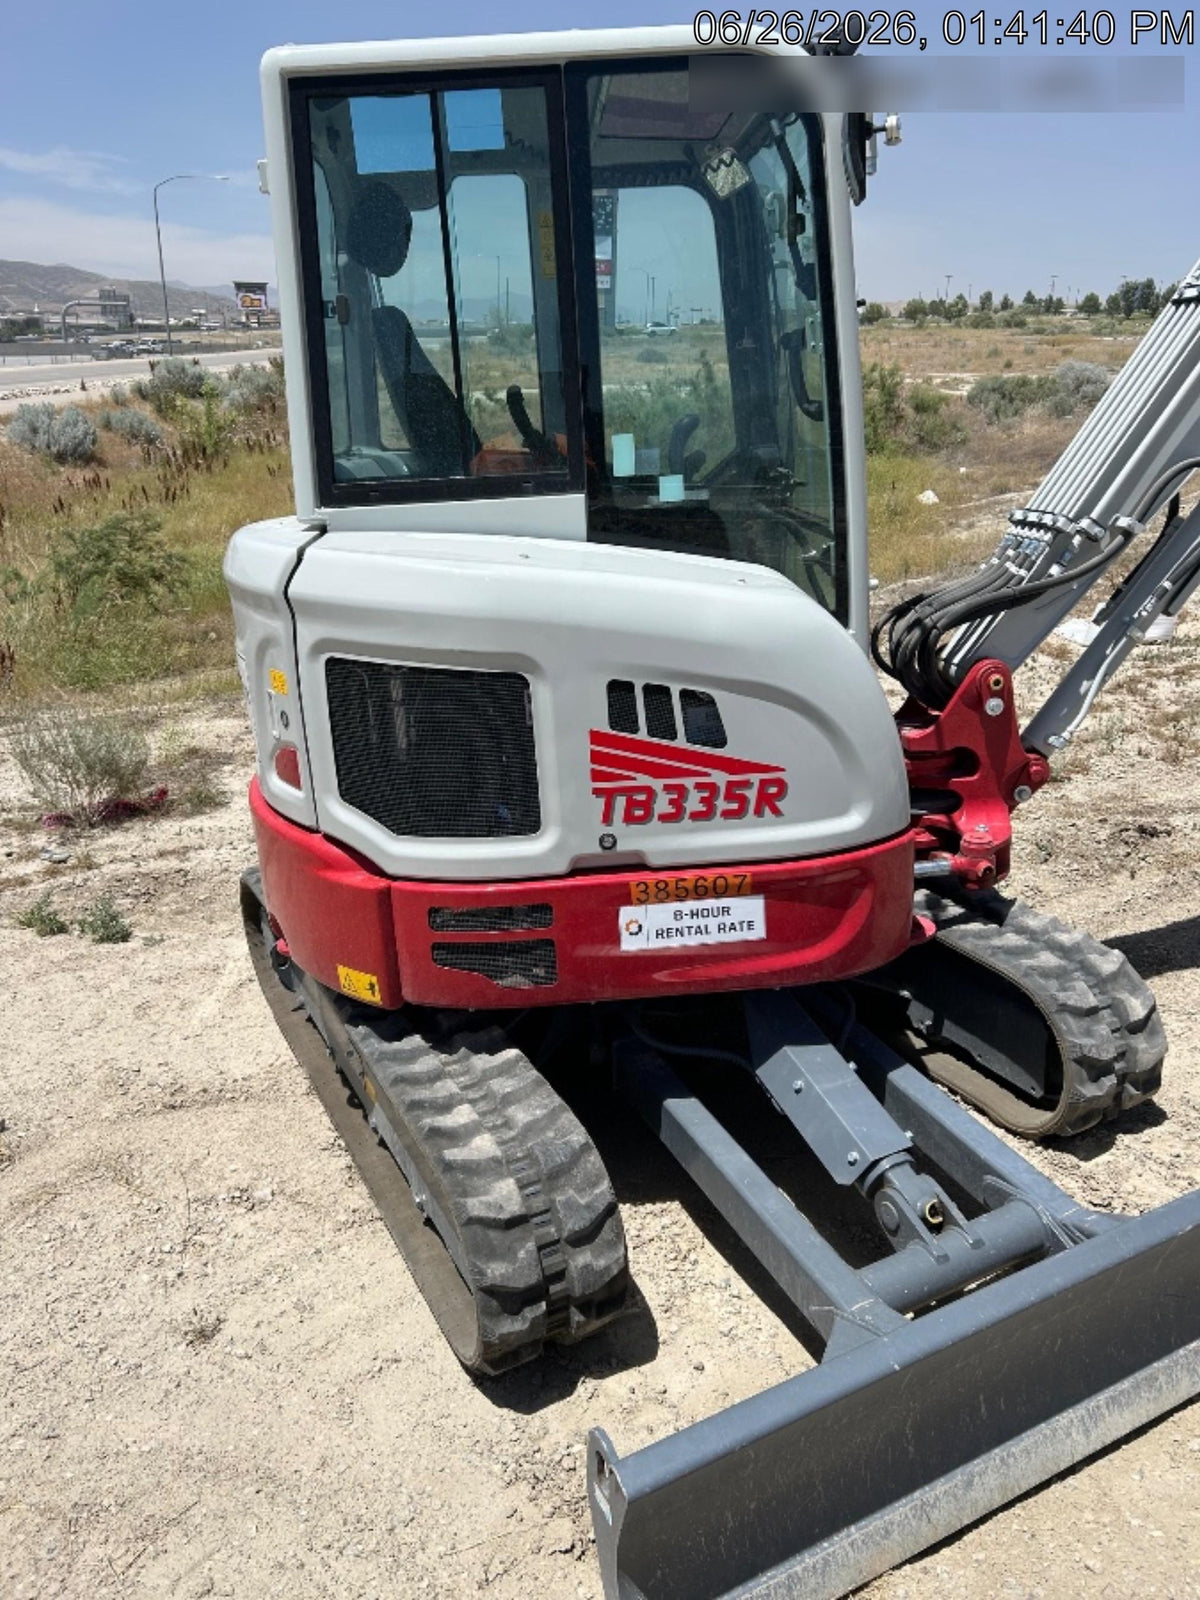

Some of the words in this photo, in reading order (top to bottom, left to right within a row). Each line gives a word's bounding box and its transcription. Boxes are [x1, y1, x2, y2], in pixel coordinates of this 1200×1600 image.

[592, 777, 788, 827] TB335R
[635, 874, 748, 904] 385607
[673, 906, 732, 922] 8-HOUR
[655, 924, 712, 940] RENTAL
[717, 920, 755, 935] RATE
